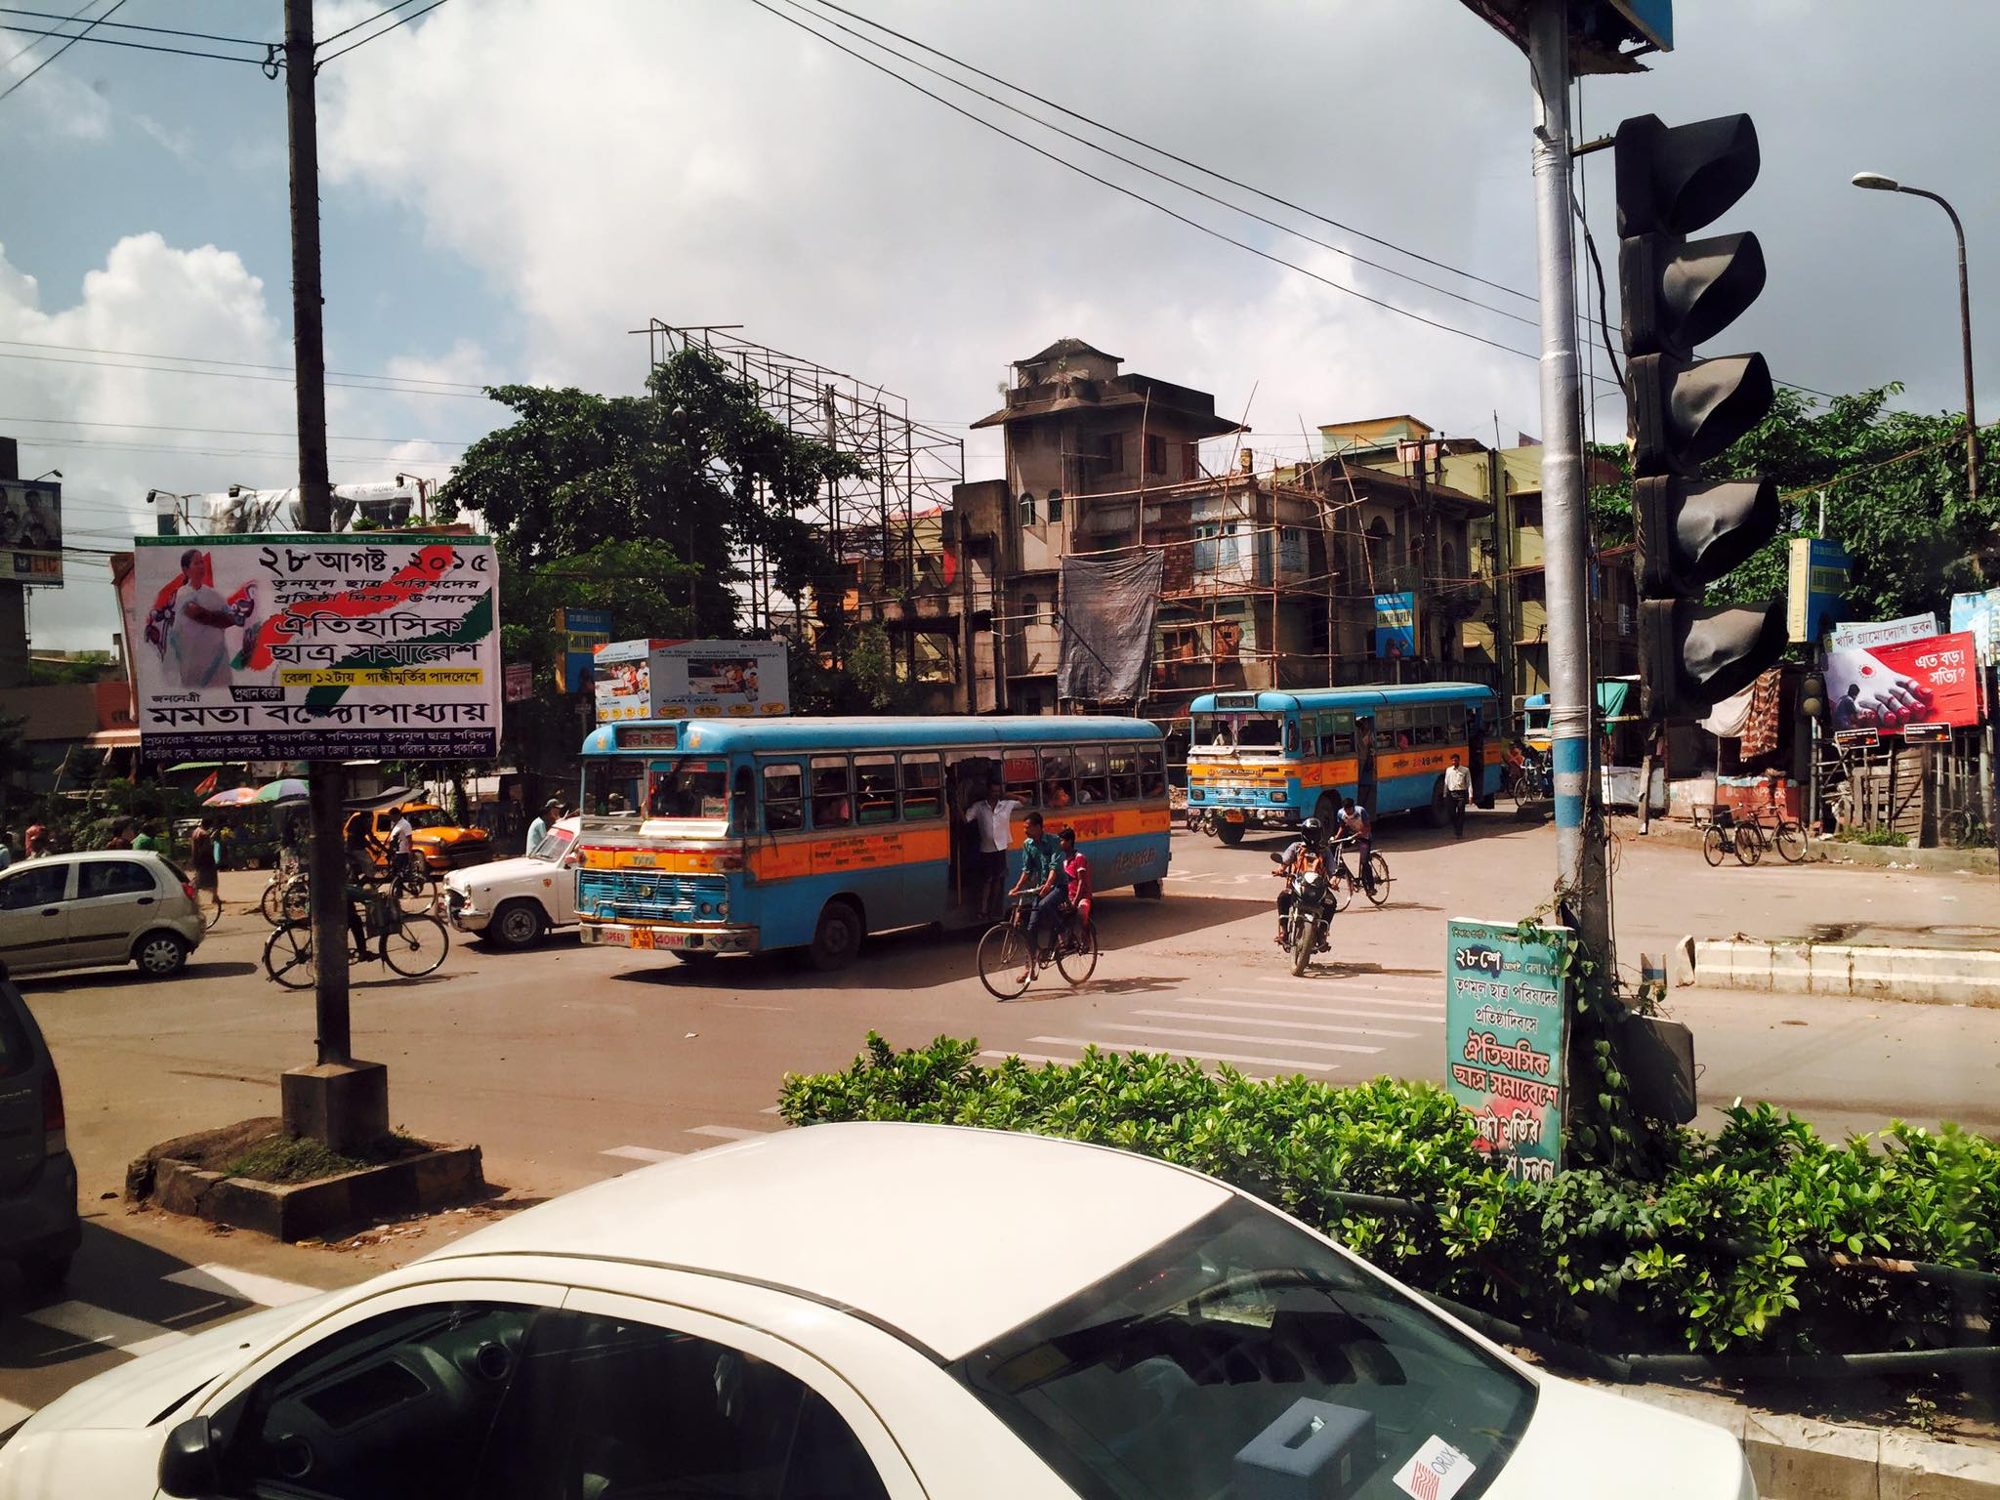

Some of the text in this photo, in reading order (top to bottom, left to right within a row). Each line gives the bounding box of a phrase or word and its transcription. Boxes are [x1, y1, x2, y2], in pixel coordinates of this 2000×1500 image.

[259, 547, 310, 577] ২৮
[408, 551, 489, 572] ২০১৫
[345, 579, 383, 589] ছাত্র
[392, 577, 480, 589] পরিষদের
[348, 592, 399, 602] দিবস
[275, 607, 466, 638] ঐতিহাসিক
[1909, 620, 1933, 635] ভবন
[267, 643, 484, 665] ছাত্র সমাবেশ
[1915, 650, 1965, 669] এত বড়!
[283, 671, 312, 684] বেলা
[314, 671, 355, 684] ১২টায়
[428, 670, 480, 683] পাদদেশে
[151, 692, 201, 704] জননেত্রী
[234, 688, 260, 701] প্রধান
[146, 702, 490, 727] মমতা বন্দ্যোপাধ্যায়
[632, 855, 656, 866] TATA
[605, 931, 626, 942] SPEED
[1454, 977, 1558, 1008] তৃণমূল ছাত্র পরিষদের
[1464, 1028, 1551, 1077] ঐতিহাসিক
[1452, 1063, 1559, 1111] ছাত্র সমাবেশে
[1501, 1109, 1542, 1151] মূর্তির
[1431, 1448, 1458, 1475] ORIX
